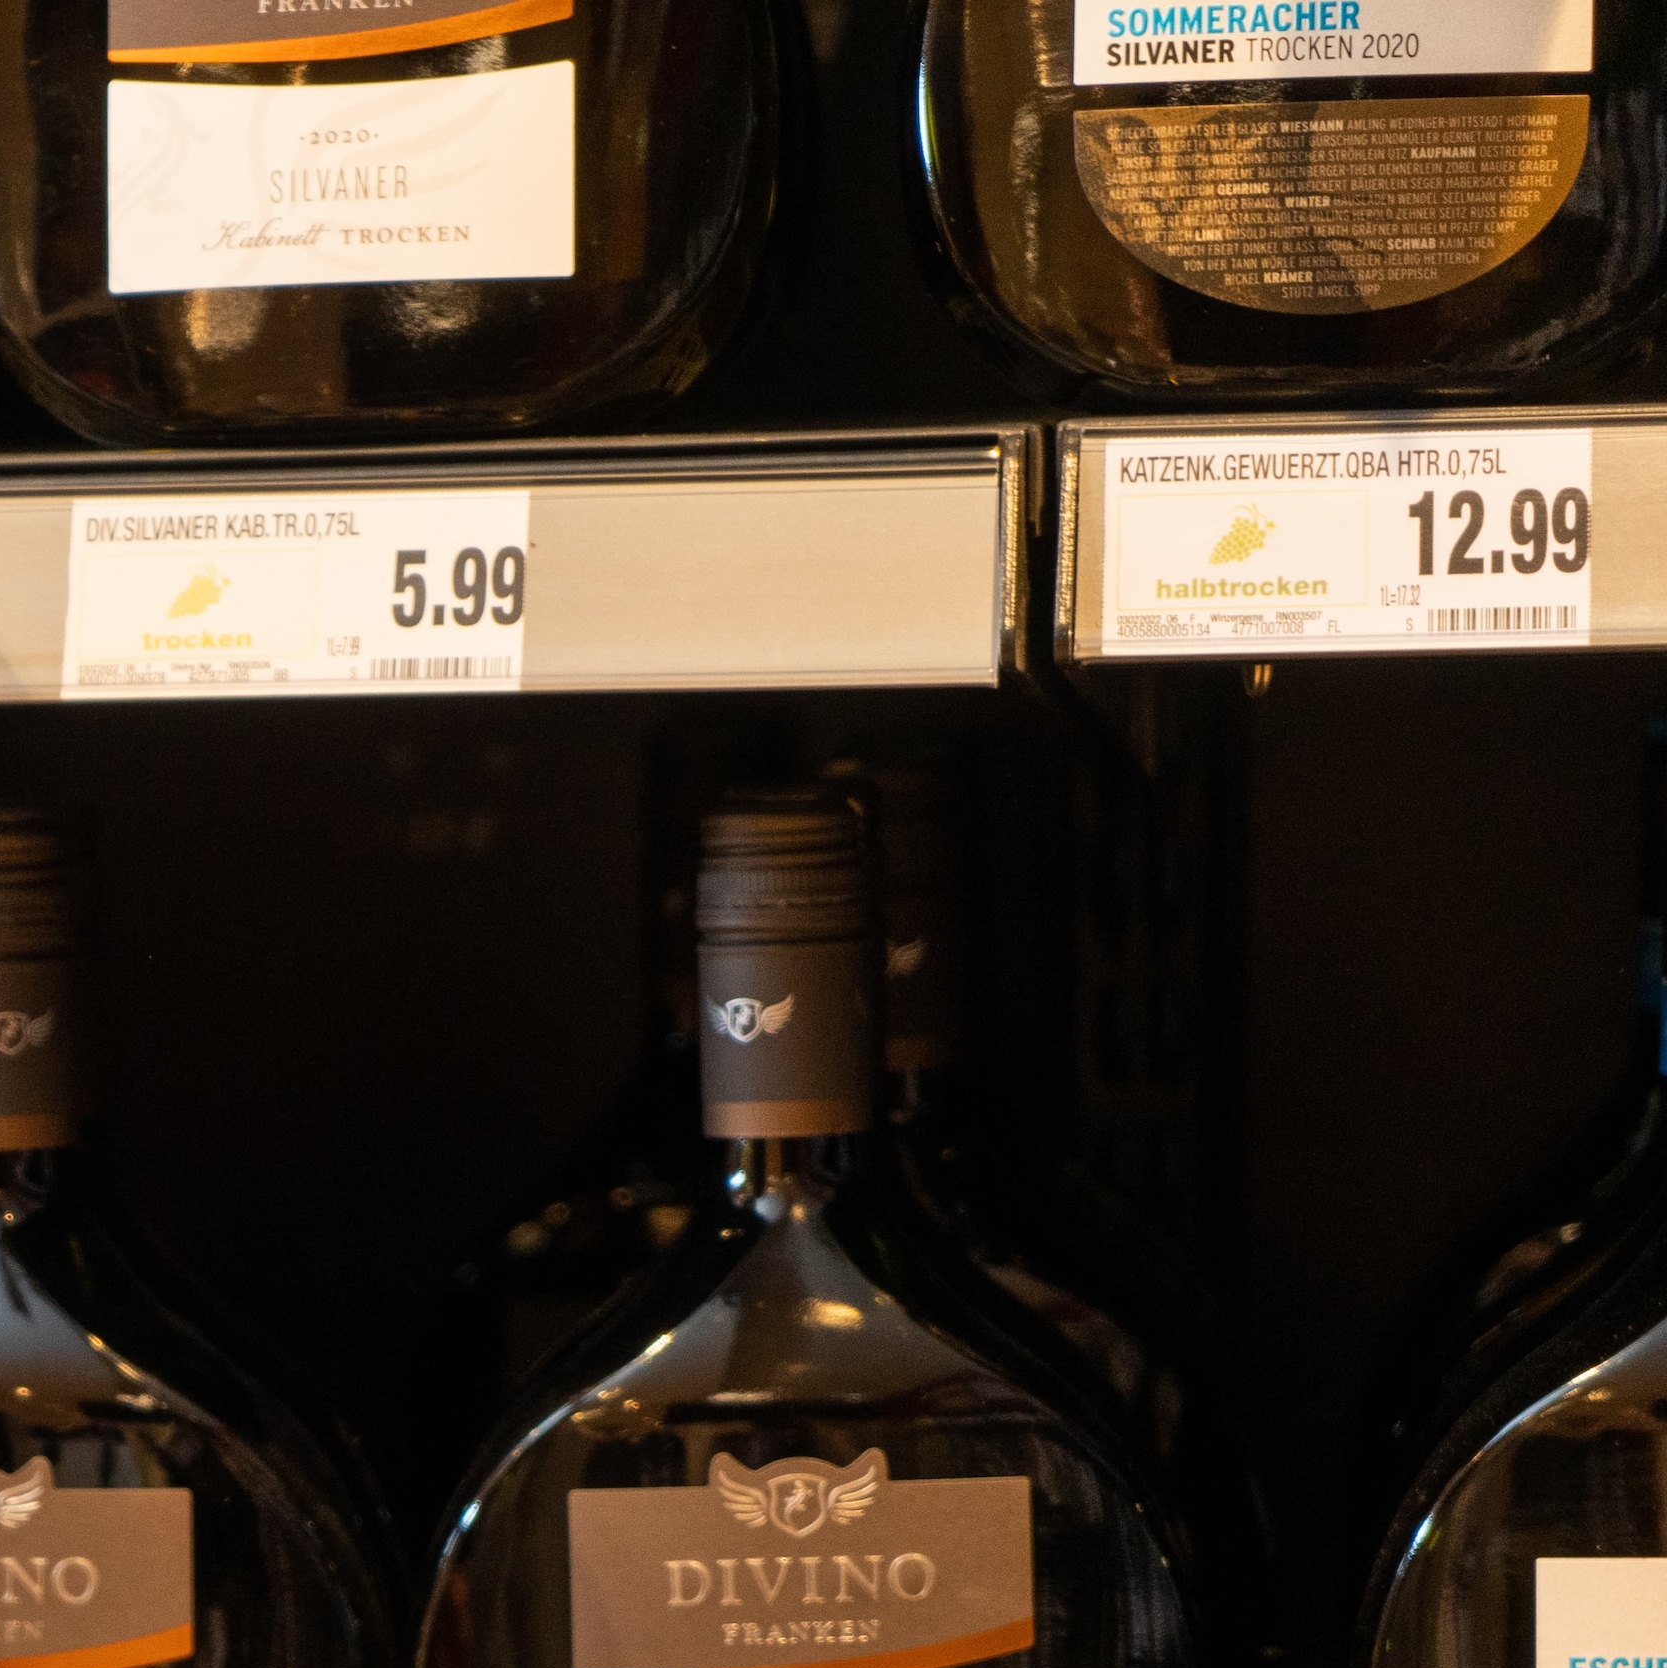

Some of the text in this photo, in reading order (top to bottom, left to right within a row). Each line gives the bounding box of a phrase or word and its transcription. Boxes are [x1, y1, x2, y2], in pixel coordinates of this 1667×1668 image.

[1107, 2, 1361, 37] SOMMERACHER
[1107, 33, 1419, 67] SILVANER TROCKEN 2020
[1280, 119, 1343, 132] WIESMANN
[1411, 146, 1476, 158] KAUFMANN
[269, 165, 410, 203] SILVANER
[1217, 183, 1270, 196] GEHRING
[1285, 195, 1330, 207] WINTER
[201, 219, 471, 255] Kabinett TROCKEN
[1195, 229, 1223, 241] LINK
[1387, 238, 1436, 250] SCHWAB
[1264, 269, 1312, 283] KRÄMER
[1120, 447, 1507, 484] KATZENK.GEWUERZT.QBA HTR.0,75L
[86, 511, 360, 542] DIV.SILVANER KAB.TR.0,75L
[1408, 487, 1589, 576] 12.99
[392, 546, 526, 629] 5.99
[1156, 576, 1328, 600] halbtrocken
[1380, 585, 1421, 607] 1L=17.32
[1231, 621, 1304, 635] 4771007008
[1327, 620, 1341, 633] FL
[142, 630, 253, 651] trocken
[664, 1552, 936, 1608] DIVINO
[721, 1618, 882, 1645] FRANKEN
